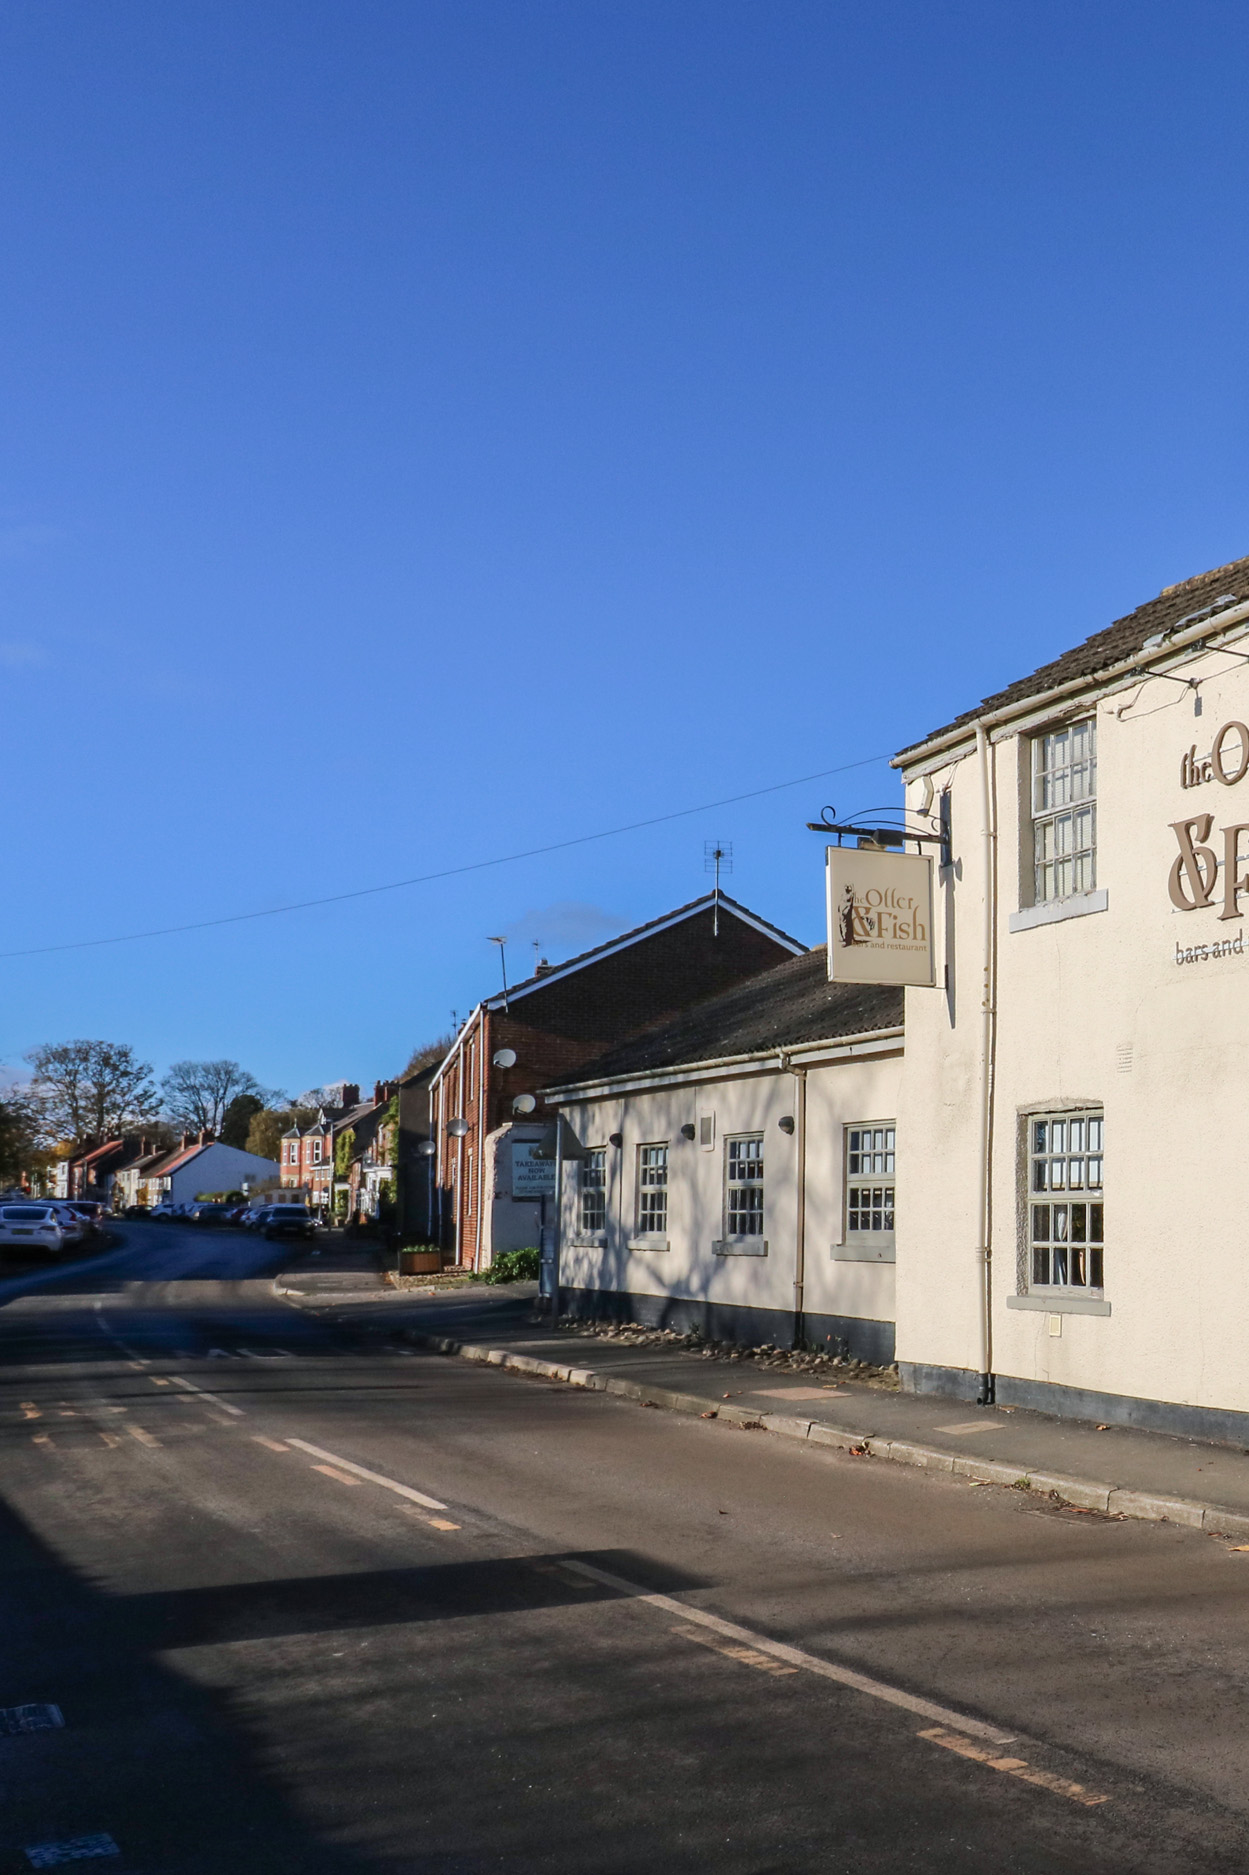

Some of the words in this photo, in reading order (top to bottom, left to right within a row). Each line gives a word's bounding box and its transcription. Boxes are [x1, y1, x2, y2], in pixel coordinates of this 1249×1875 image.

[875, 905, 926, 941] Fish
[870, 941, 885, 949] and
[886, 943, 927, 952] restaurant
[1176, 941, 1208, 965] bars
[1212, 928, 1243, 954] and
